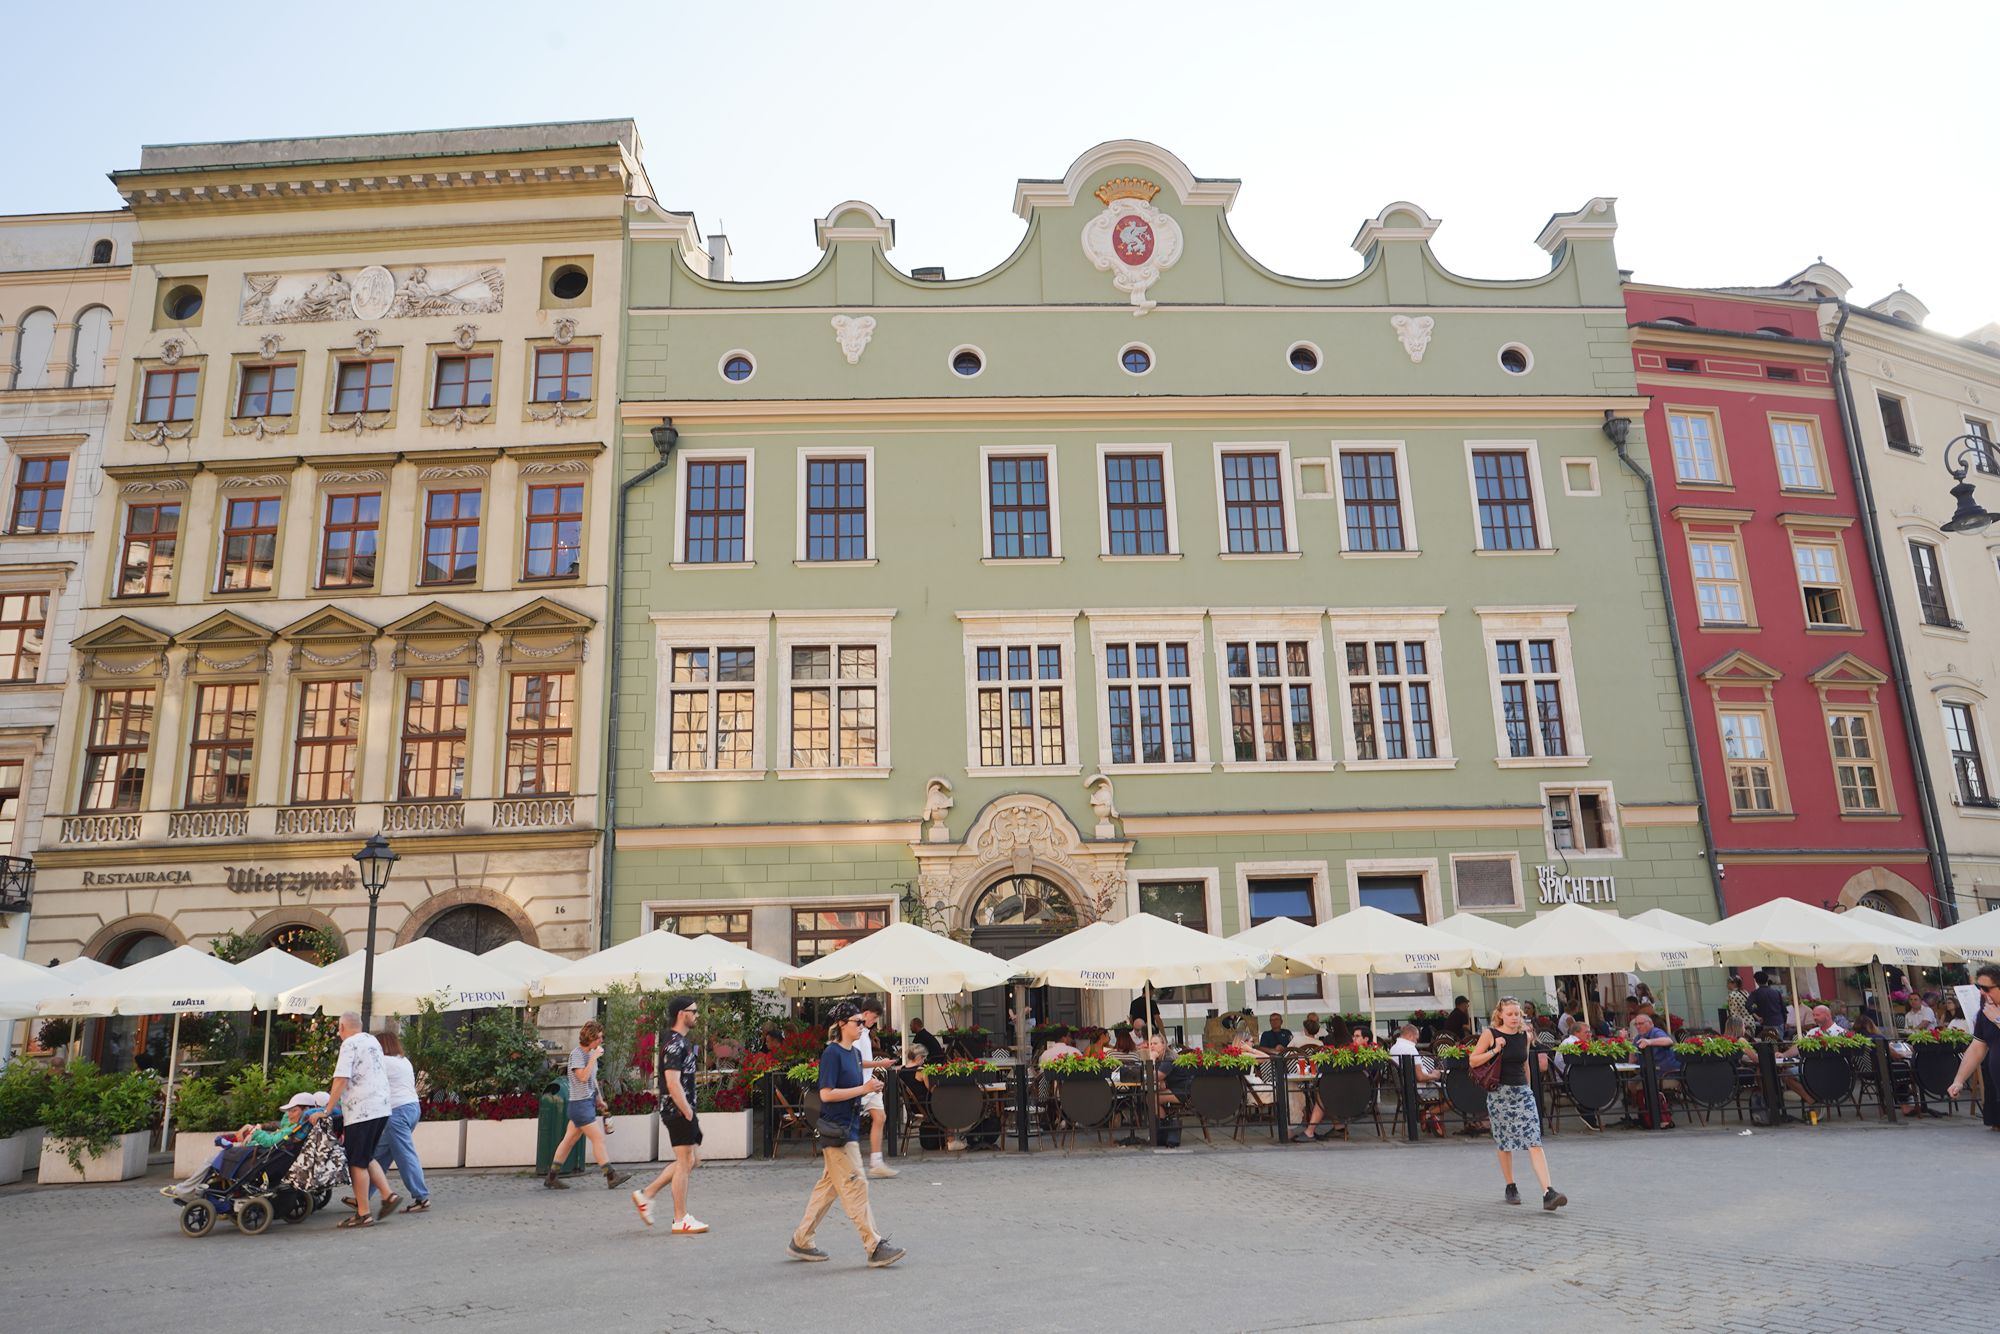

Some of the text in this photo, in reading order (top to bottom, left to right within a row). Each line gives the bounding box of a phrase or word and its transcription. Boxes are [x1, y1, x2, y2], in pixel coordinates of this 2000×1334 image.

[1536, 865, 1556, 878] THE
[82, 864, 356, 896] RESTAURACJA Wierzynek
[1538, 876, 1617, 904] SPAGHETTI
[555, 905, 566, 914] 16
[1404, 953, 1440, 962] PERONI
[1660, 951, 1688, 961] PERONI
[1960, 949, 1993, 957] PERONI
[670, 972, 717, 984] PERONI
[1080, 970, 1115, 980] PERONI
[892, 976, 929, 985] PERONI
[172, 998, 205, 1006] LAVAZZA
[460, 991, 505, 1003] PERONI
